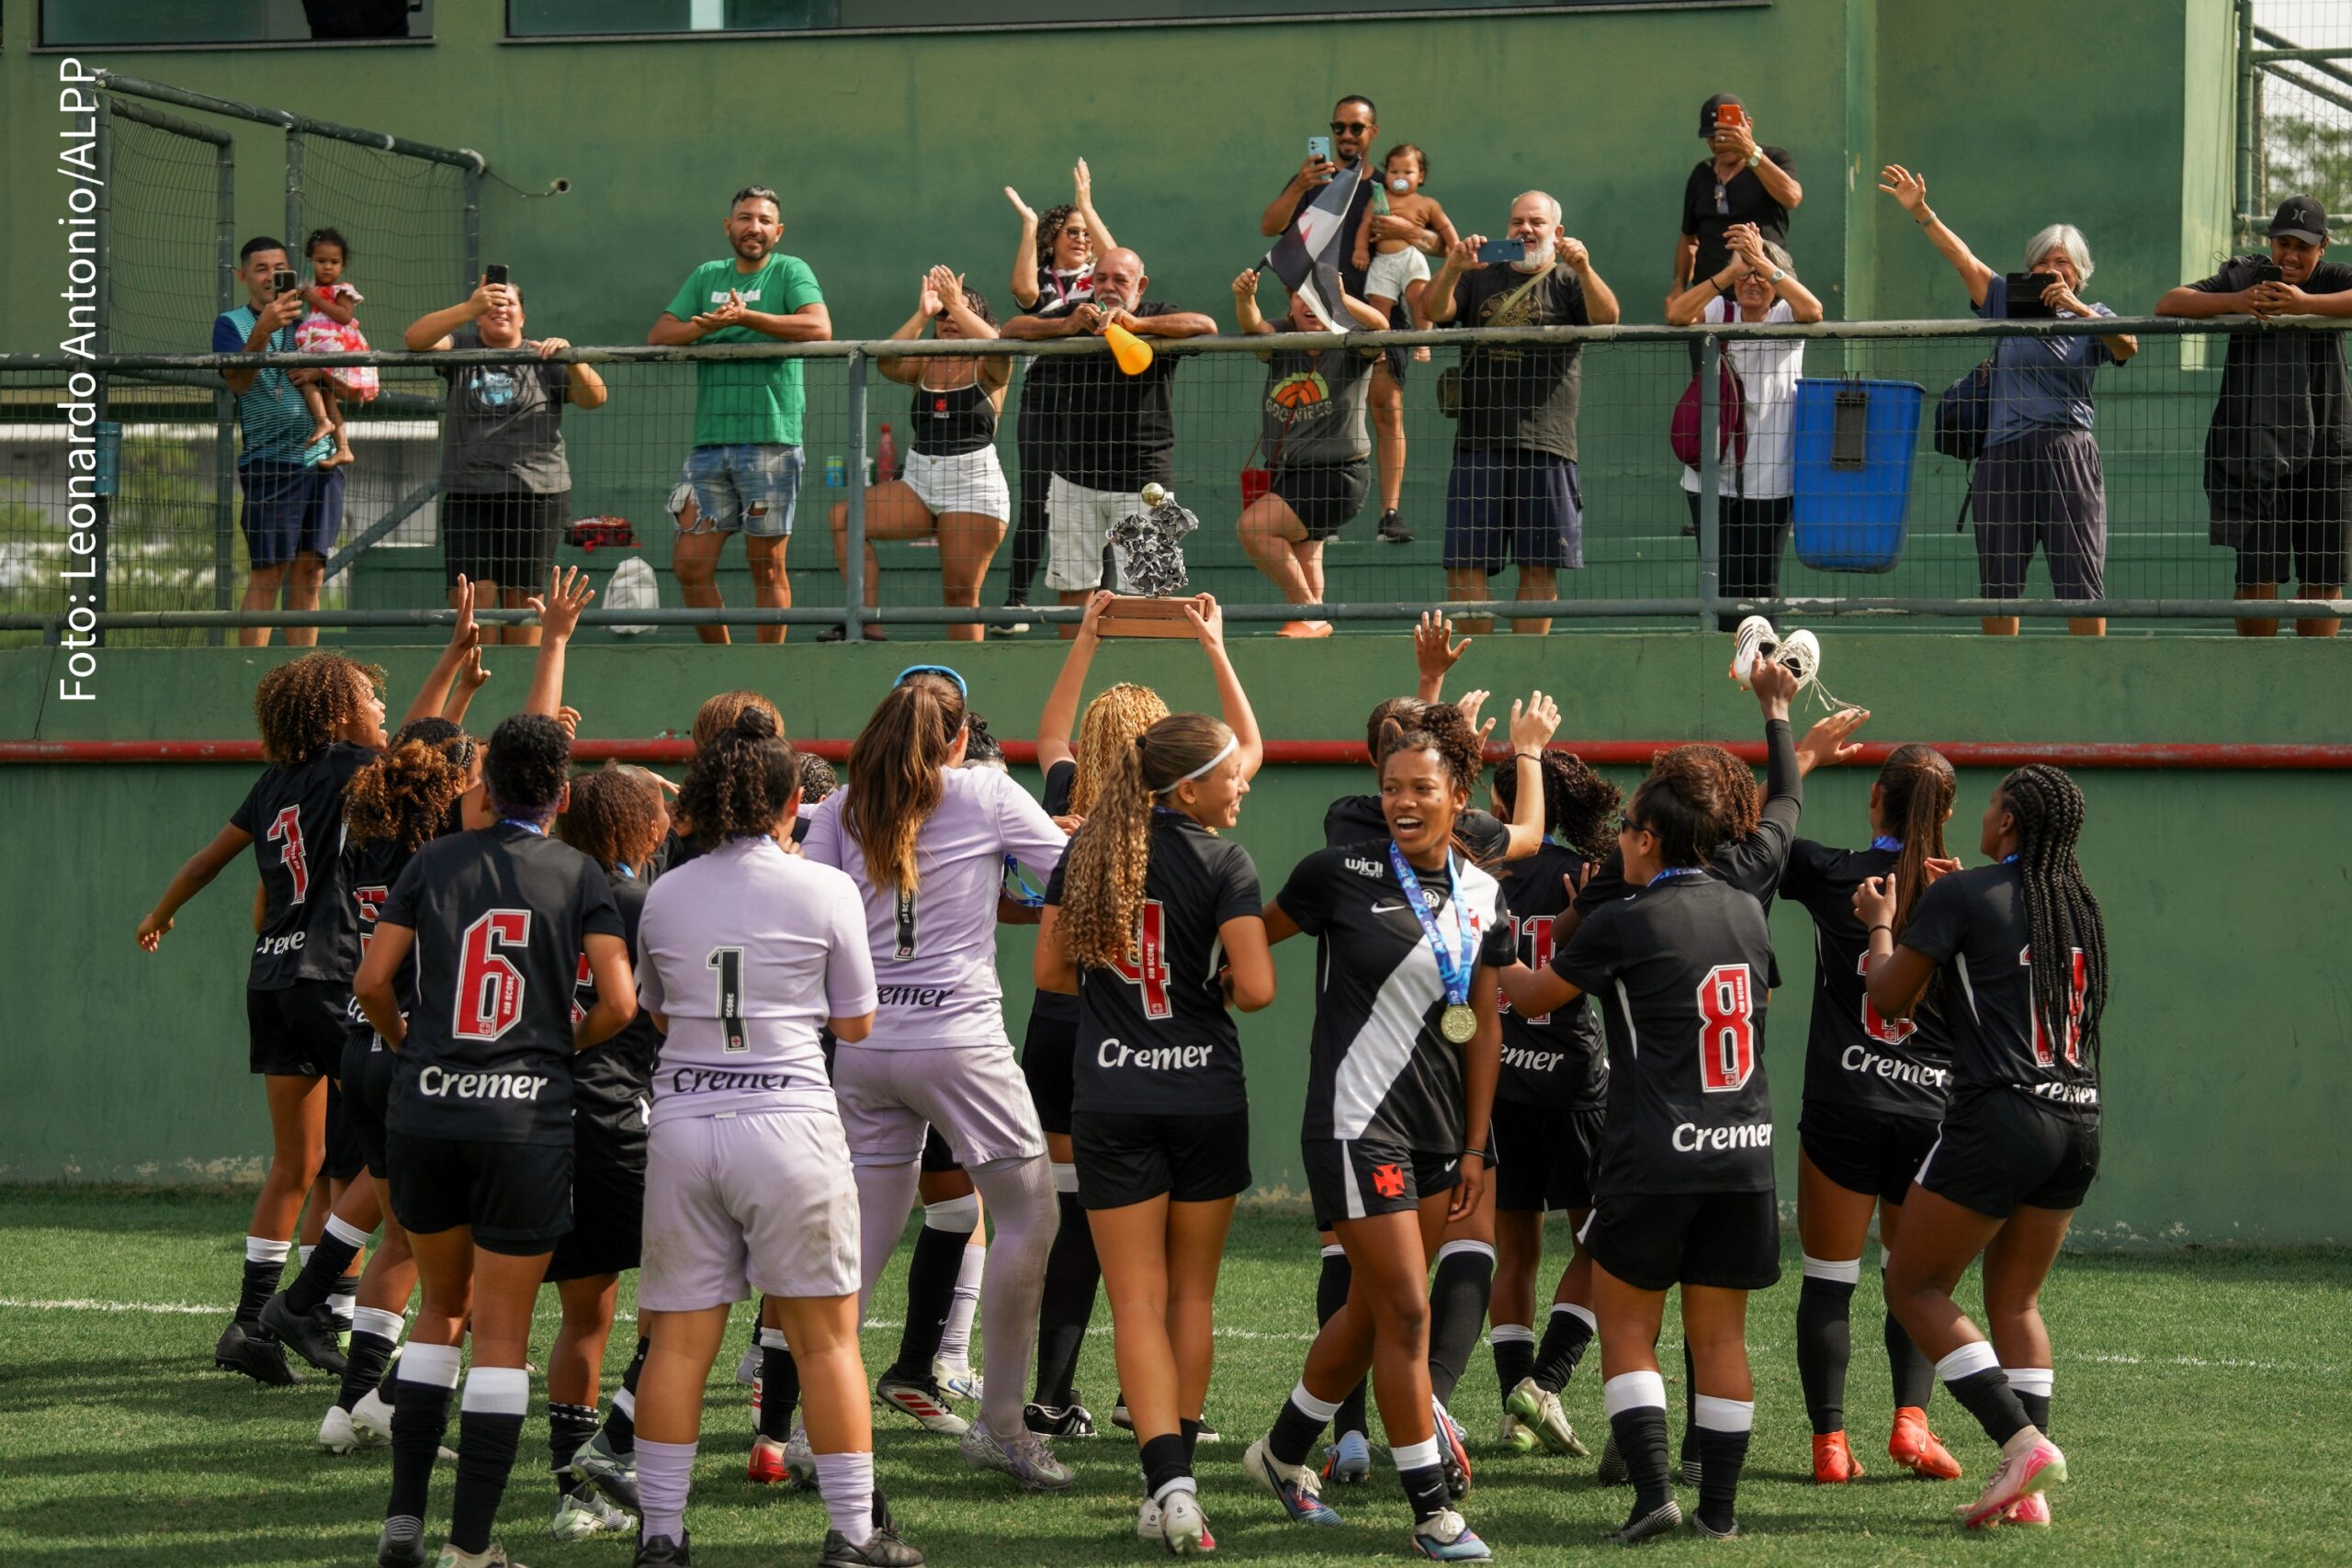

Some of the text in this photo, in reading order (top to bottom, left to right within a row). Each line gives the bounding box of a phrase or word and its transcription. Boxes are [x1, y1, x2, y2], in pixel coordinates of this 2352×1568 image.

[267, 804, 309, 906] 7
[1102, 899, 1173, 1021] 4
[1147, 942, 1155, 966] SCORE
[453, 908, 533, 1042] 6
[505, 975, 515, 1000] SCORE
[1736, 976, 1745, 1000] SCORE
[706, 945, 751, 1055] 1
[877, 987, 955, 1008] emer
[1696, 963, 1755, 1093] 8
[1097, 1038, 1213, 1071] Cremer
[1498, 1043, 1565, 1073] emer
[1841, 1044, 1947, 1088] Cremer
[419, 1066, 549, 1100] Cremer
[673, 1067, 792, 1093] Cremer
[1671, 1122, 1773, 1153] Cremer
